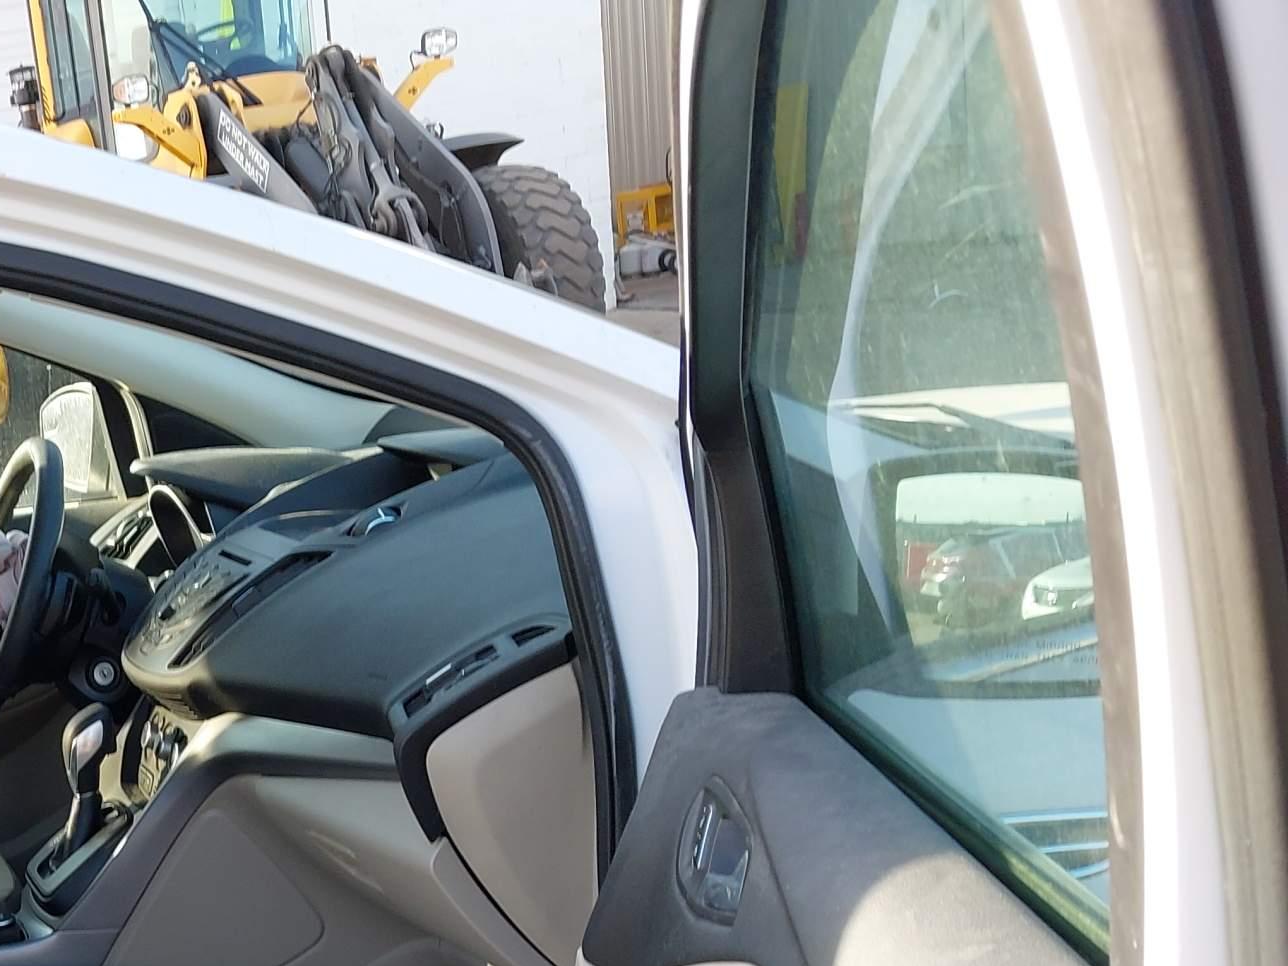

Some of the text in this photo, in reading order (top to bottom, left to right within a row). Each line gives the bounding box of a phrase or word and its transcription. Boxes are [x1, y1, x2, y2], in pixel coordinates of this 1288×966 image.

[219, 109, 269, 174] DO NOT WALK
[222, 131, 264, 186] UNDER MAST
